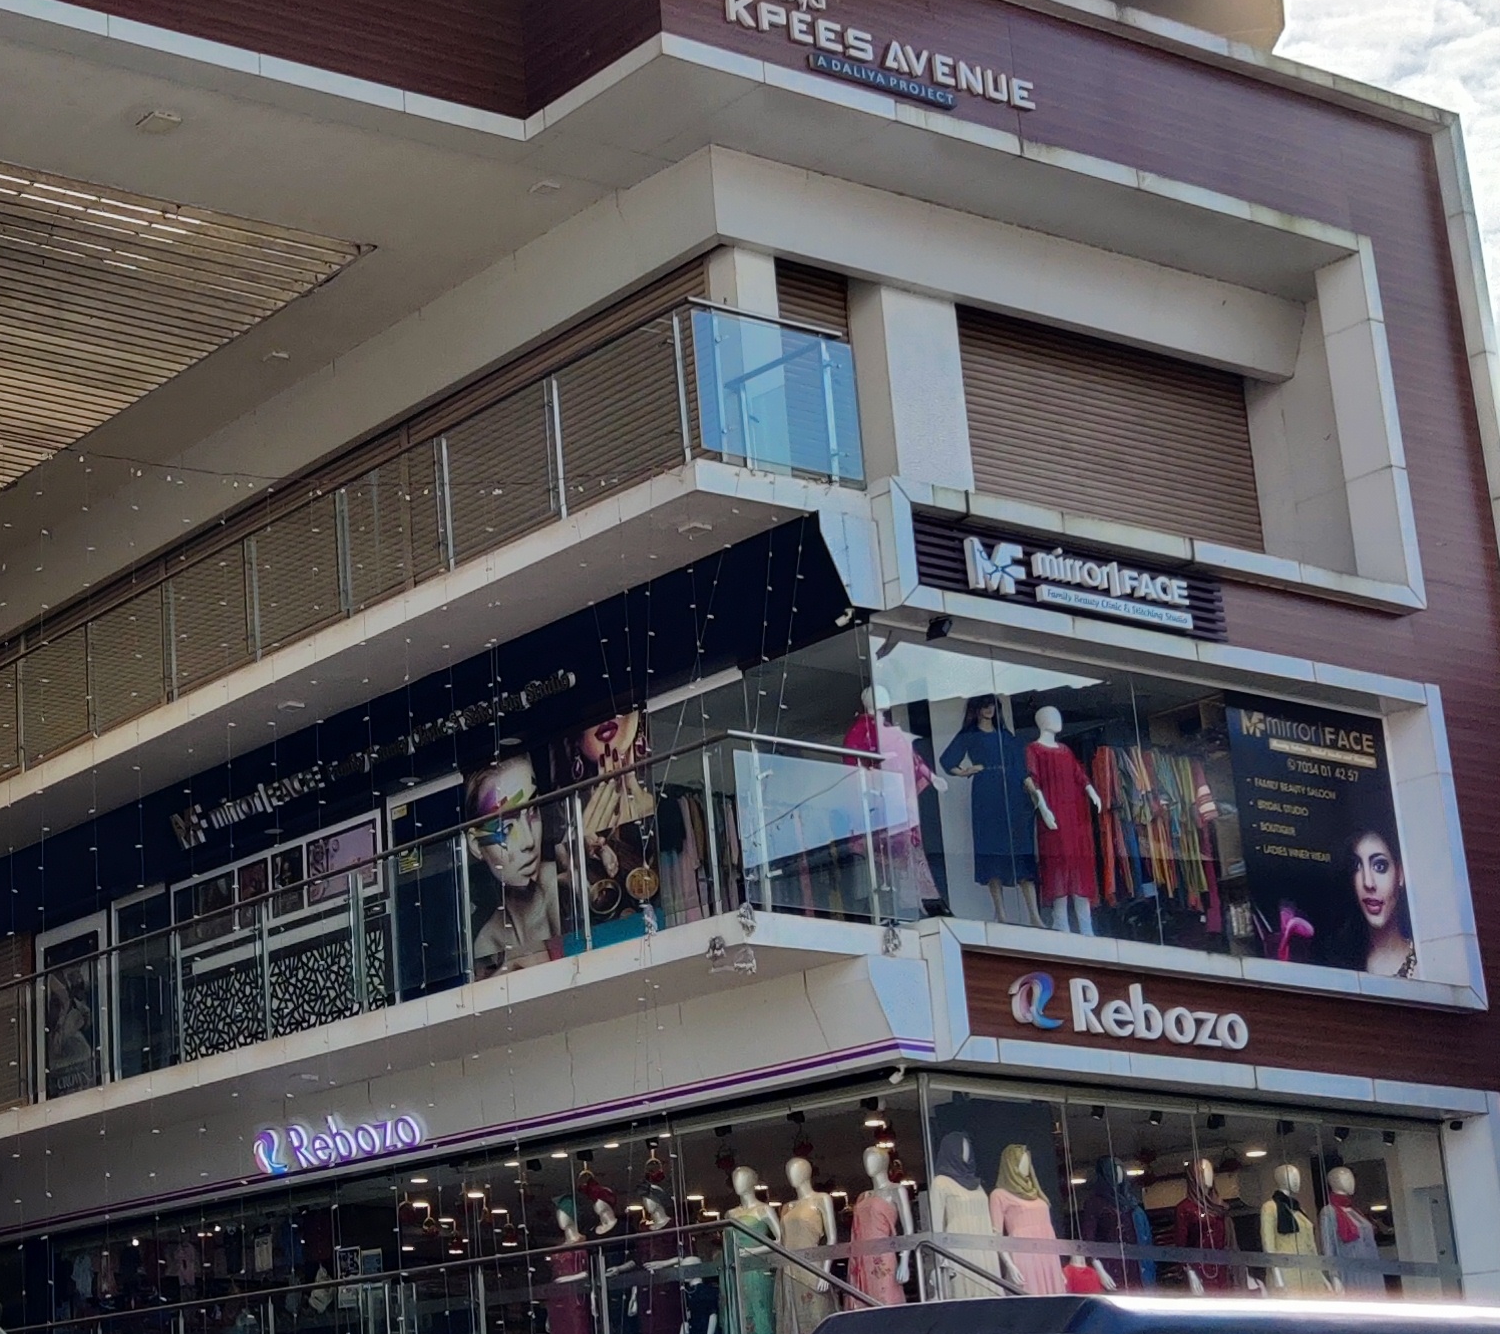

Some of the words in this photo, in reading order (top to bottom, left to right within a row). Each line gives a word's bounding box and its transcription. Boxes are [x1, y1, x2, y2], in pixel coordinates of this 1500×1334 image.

[816, 56, 829, 69] A
[831, 58, 886, 86] DALIYA
[888, 76, 955, 106] PROJECT
[883, 40, 1038, 111] AVENUE
[1047, 588, 1072, 603] Family
[1074, 594, 1100, 608] Beauty
[1101, 598, 1122, 612] Clinic
[1132, 604, 1164, 621] Stitching
[1165, 612, 1189, 625] Studio
[1325, 726, 1376, 754] FACE
[1069, 977, 1249, 1051] Rebozo
[287, 1114, 422, 1169] Rebozo
